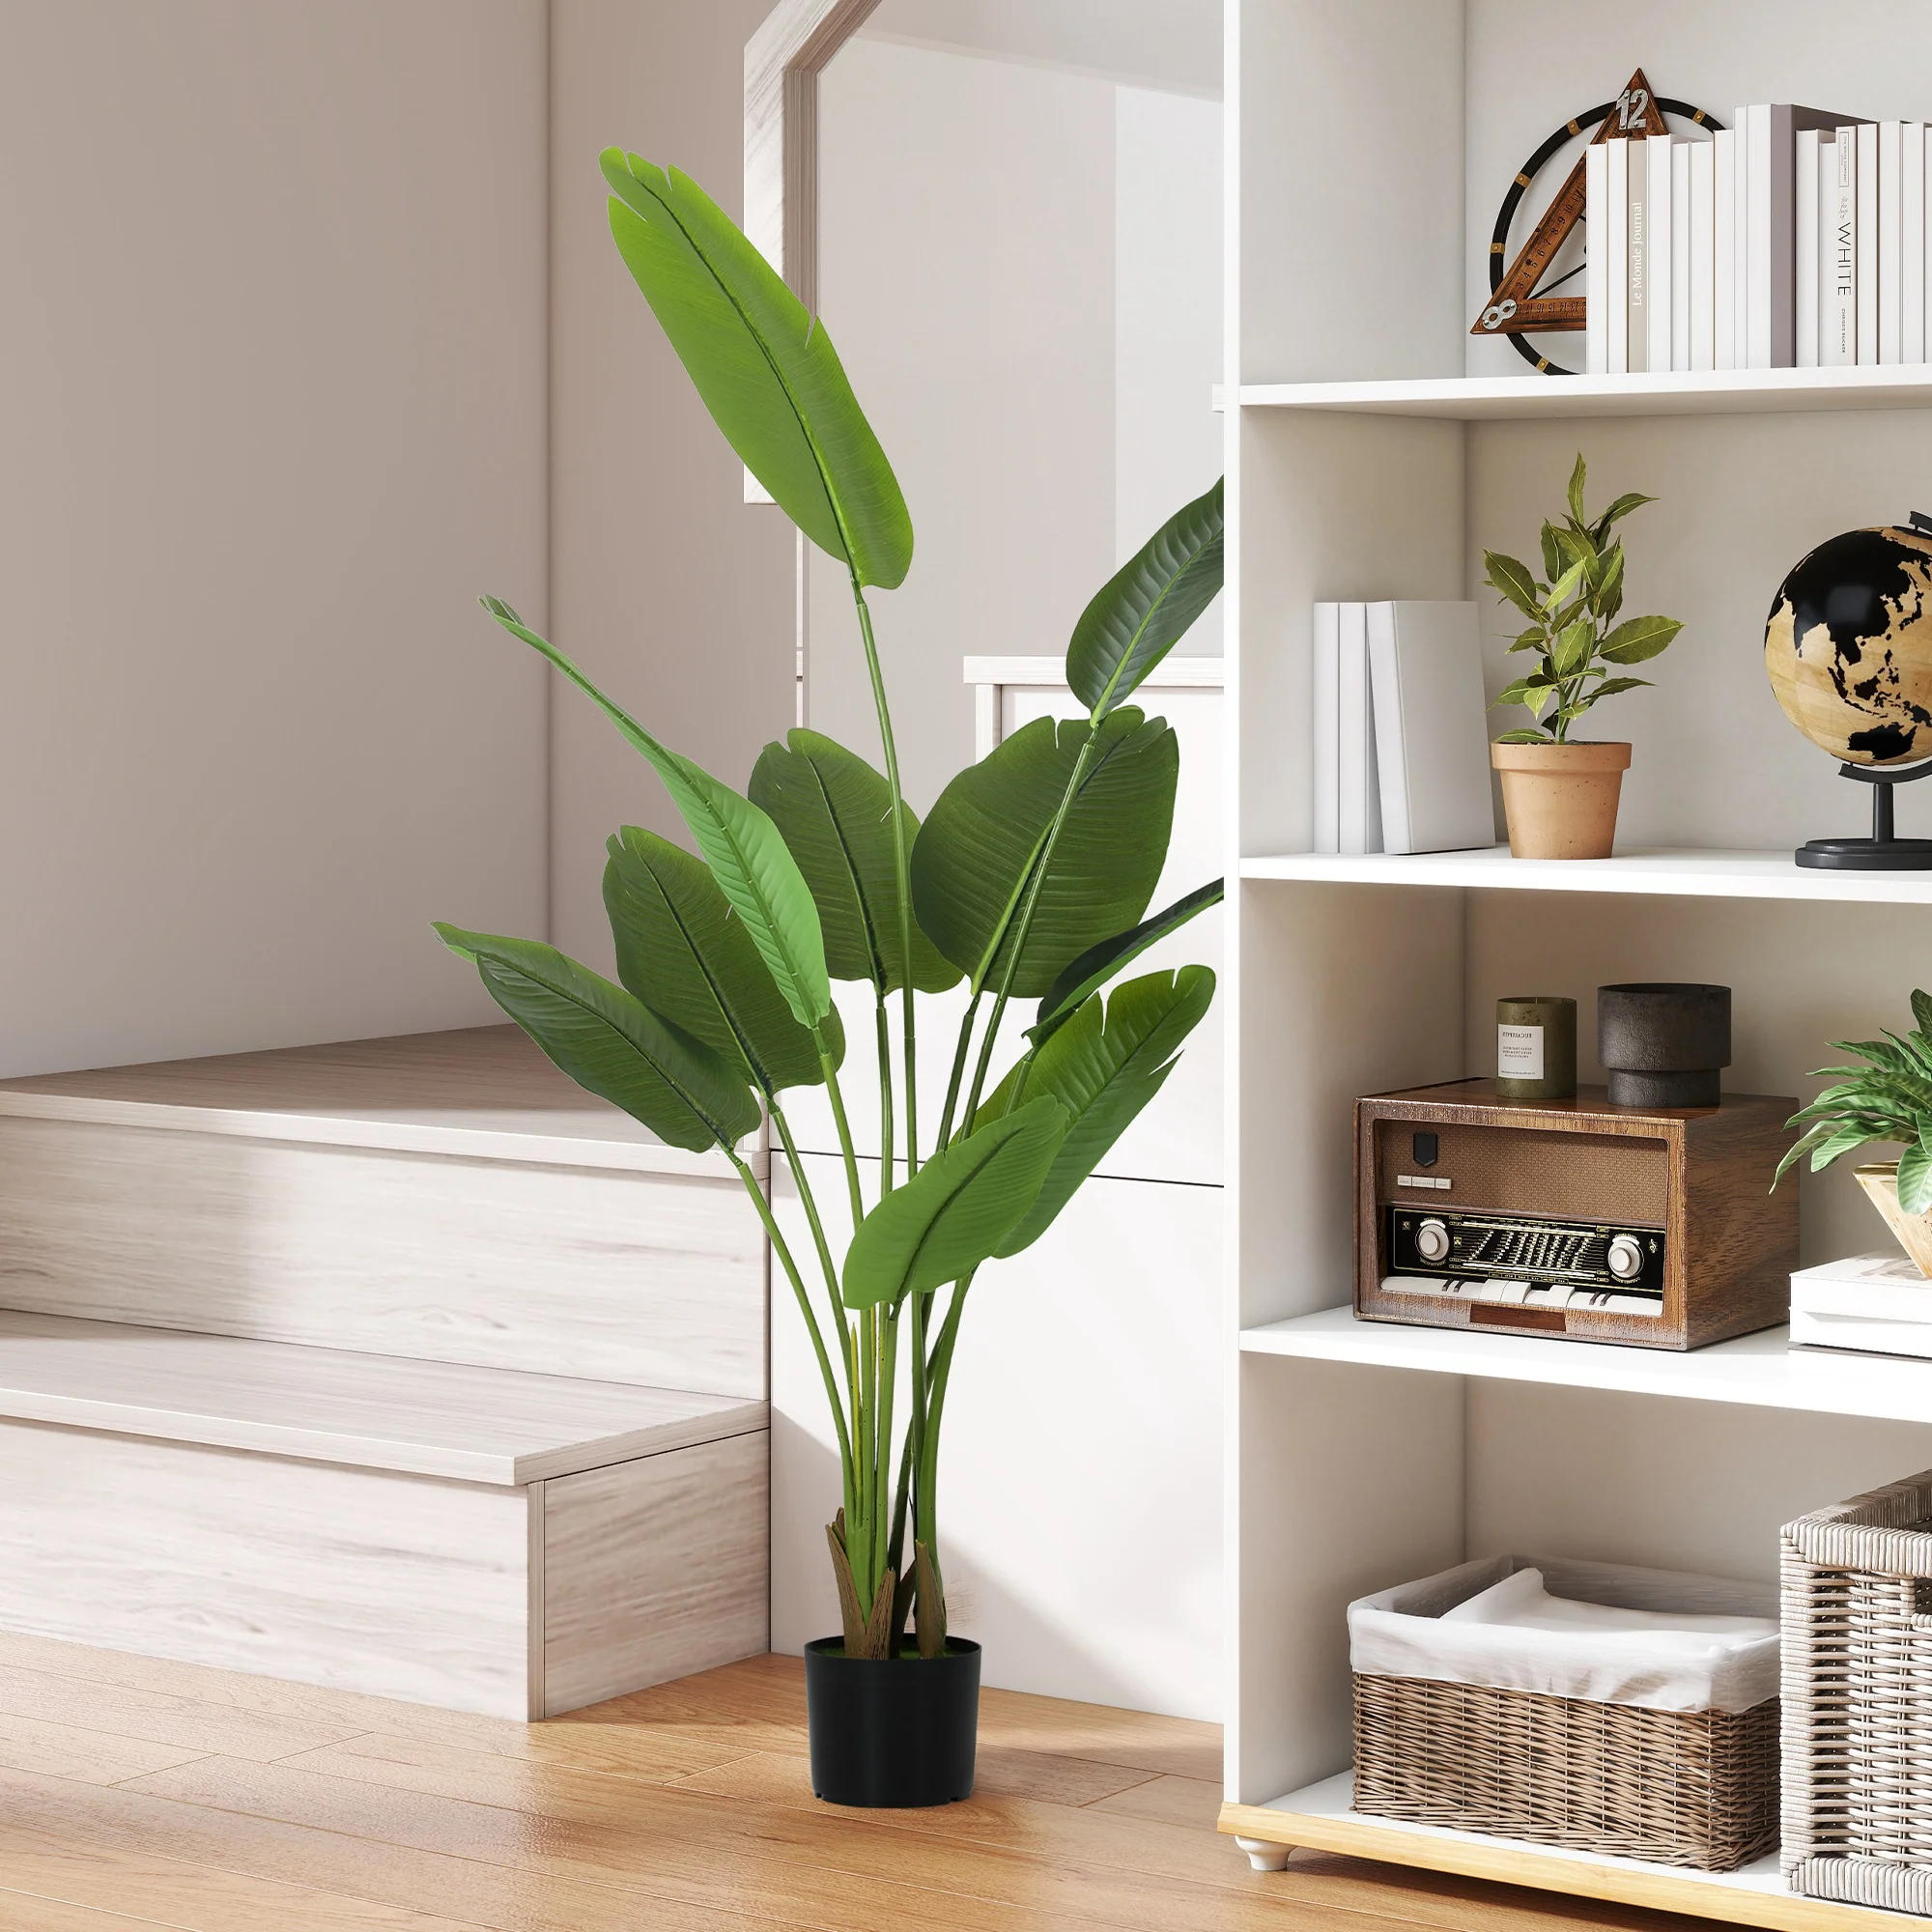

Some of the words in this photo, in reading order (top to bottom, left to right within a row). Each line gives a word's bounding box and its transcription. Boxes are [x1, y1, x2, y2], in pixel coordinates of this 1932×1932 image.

[1615, 88, 1649, 130] 12
[1537, 248, 1546, 257] 6
[1557, 215, 1566, 224] 9
[1564, 204, 1574, 214] 10
[1633, 202, 1643, 245] Journal
[1633, 247, 1642, 289] Monde
[1837, 222, 1852, 297] WHITE
[1482, 298, 1518, 329] 8
[1633, 292, 1642, 307] Le
